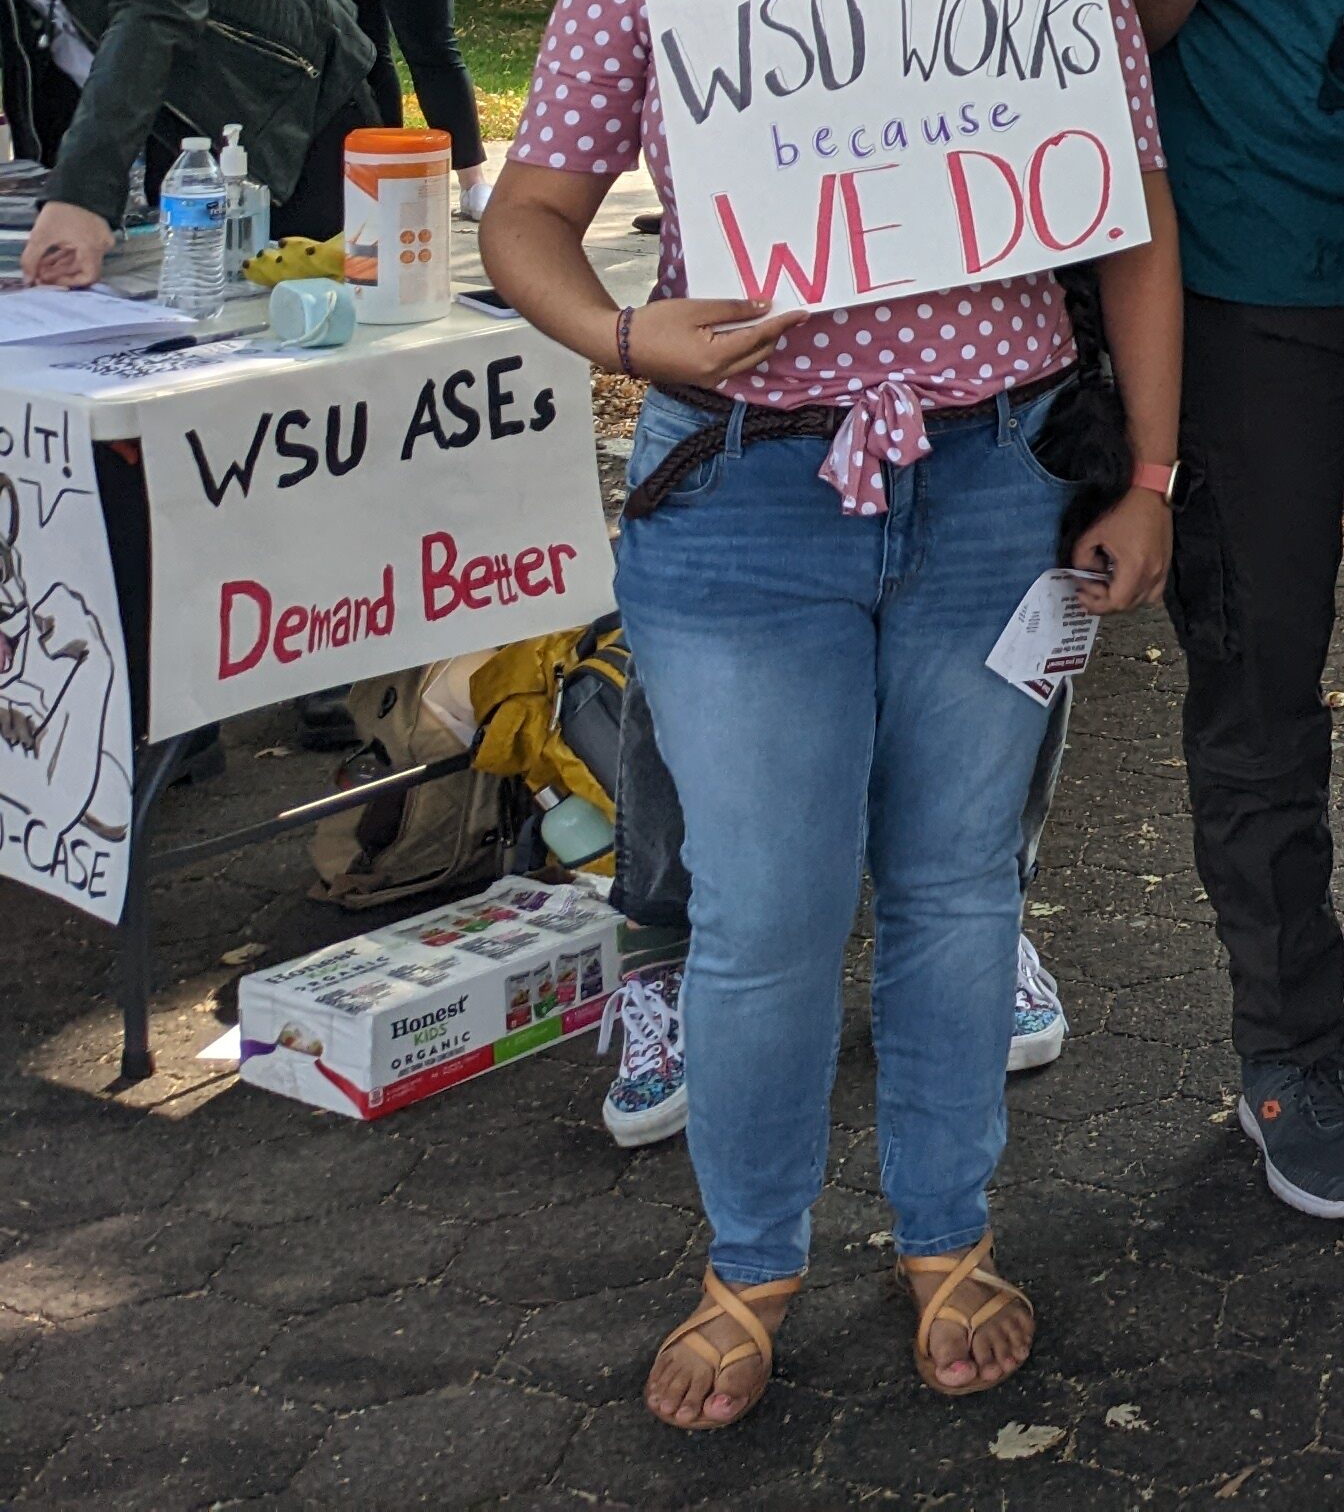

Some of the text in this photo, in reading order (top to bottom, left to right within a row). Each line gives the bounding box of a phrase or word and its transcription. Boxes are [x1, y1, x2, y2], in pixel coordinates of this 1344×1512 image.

[770, 100, 1020, 170] because
[711, 129, 1125, 306] WE DO.
[24, 402, 72, 478] IT!
[186, 354, 556, 508] WSU ASEs
[218, 531, 578, 681] Demand Better
[391, 994, 469, 1039] Honest
[391, 1031, 471, 1070] ORGANIC
[414, 1022, 449, 1046] KIDS
